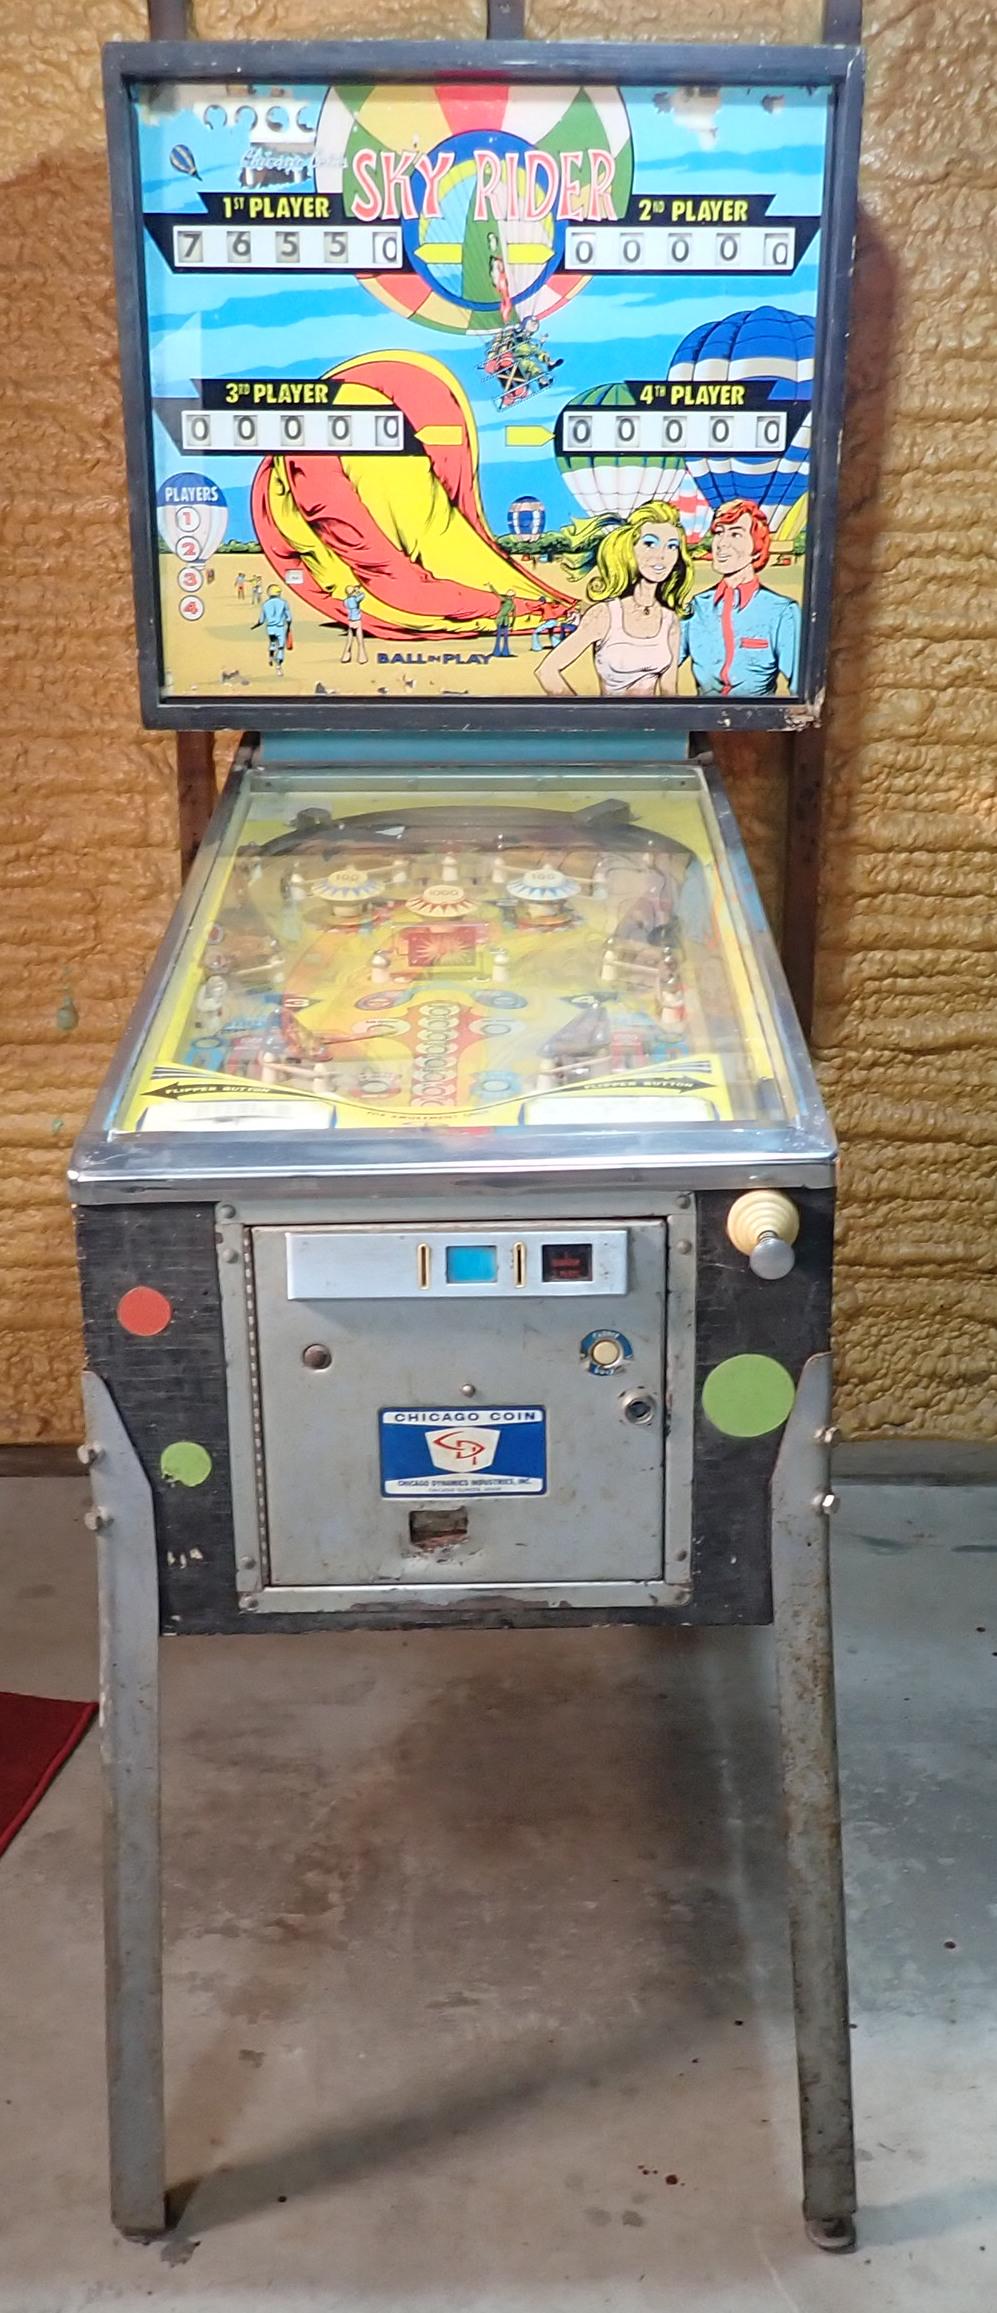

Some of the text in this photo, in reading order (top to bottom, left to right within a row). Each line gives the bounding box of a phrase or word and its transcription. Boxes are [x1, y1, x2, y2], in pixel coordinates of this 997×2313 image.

[351, 148, 619, 222] SKY RIDER
[250, 196, 330, 219] PLAYER
[672, 199, 749, 222] PLAYER
[253, 383, 329, 404] PLAYER
[670, 384, 746, 406] PLAYER
[164, 486, 219, 502] PLAYERS
[182, 512, 191, 526] 1
[180, 542, 196, 556] 2
[182, 573, 197, 587] 3
[182, 600, 198, 614] 4
[377, 652, 427, 665] BALL
[442, 653, 492, 665] PLAY
[165, 1086, 217, 1095] FLIPPER
[394, 1411, 536, 1423] CHICAGO COIN
[397, 1480, 430, 1488] CHICAGO
[431, 1479, 469, 1487] DYNAMICS
